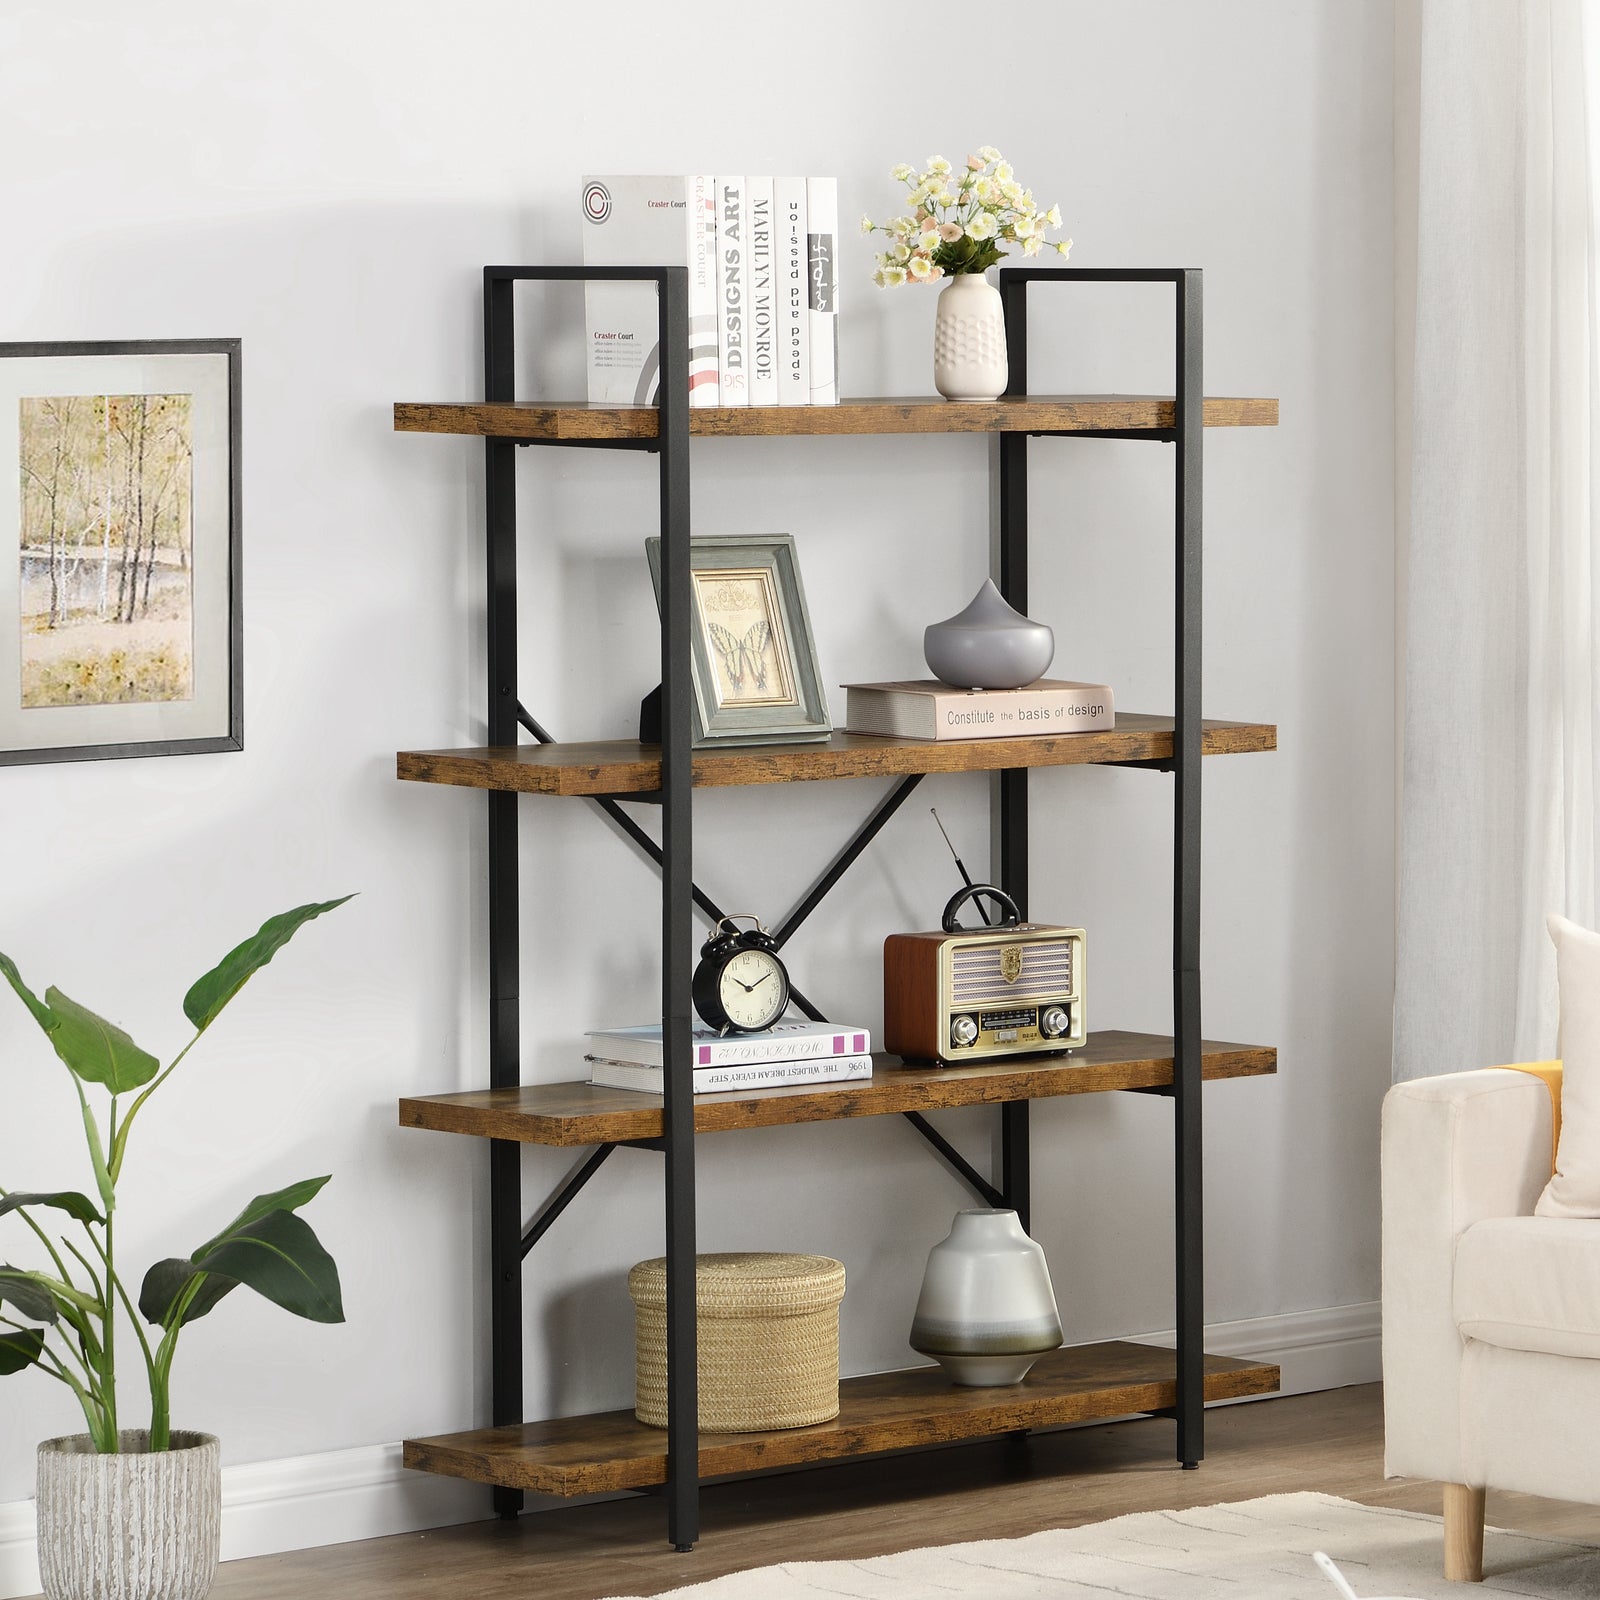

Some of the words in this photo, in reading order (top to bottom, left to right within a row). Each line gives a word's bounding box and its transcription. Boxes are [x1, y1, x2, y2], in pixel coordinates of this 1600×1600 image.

[647, 200, 669, 208] Craster
[670, 200, 687, 208] Court
[696, 175, 705, 239] CRASTER
[724, 185, 740, 242] ART
[753, 199, 770, 289] MARILYN
[789, 202, 799, 279] passion
[697, 244, 706, 288] COURT
[725, 249, 742, 368] DESIGNS
[790, 287, 800, 319] and
[593, 331, 617, 340] Craster
[617, 331, 634, 340] Court
[755, 295, 771, 380] MONROE
[791, 327, 800, 381] speed
[947, 709, 995, 725] Constitute
[1001, 712, 1014, 721] the
[1018, 707, 1050, 721] basis
[1054, 706, 1064, 718] of
[1067, 703, 1104, 718] design
[743, 956, 750, 966] 12
[735, 1010, 741, 1019] 7
[758, 1069, 786, 1079] DREAM
[787, 1066, 820, 1077] WILDEST
[823, 1064, 839, 1073] THE
[848, 1061, 867, 1072] 1996
[709, 1074, 730, 1083] STEP
[730, 1072, 757, 1082] EVERY
